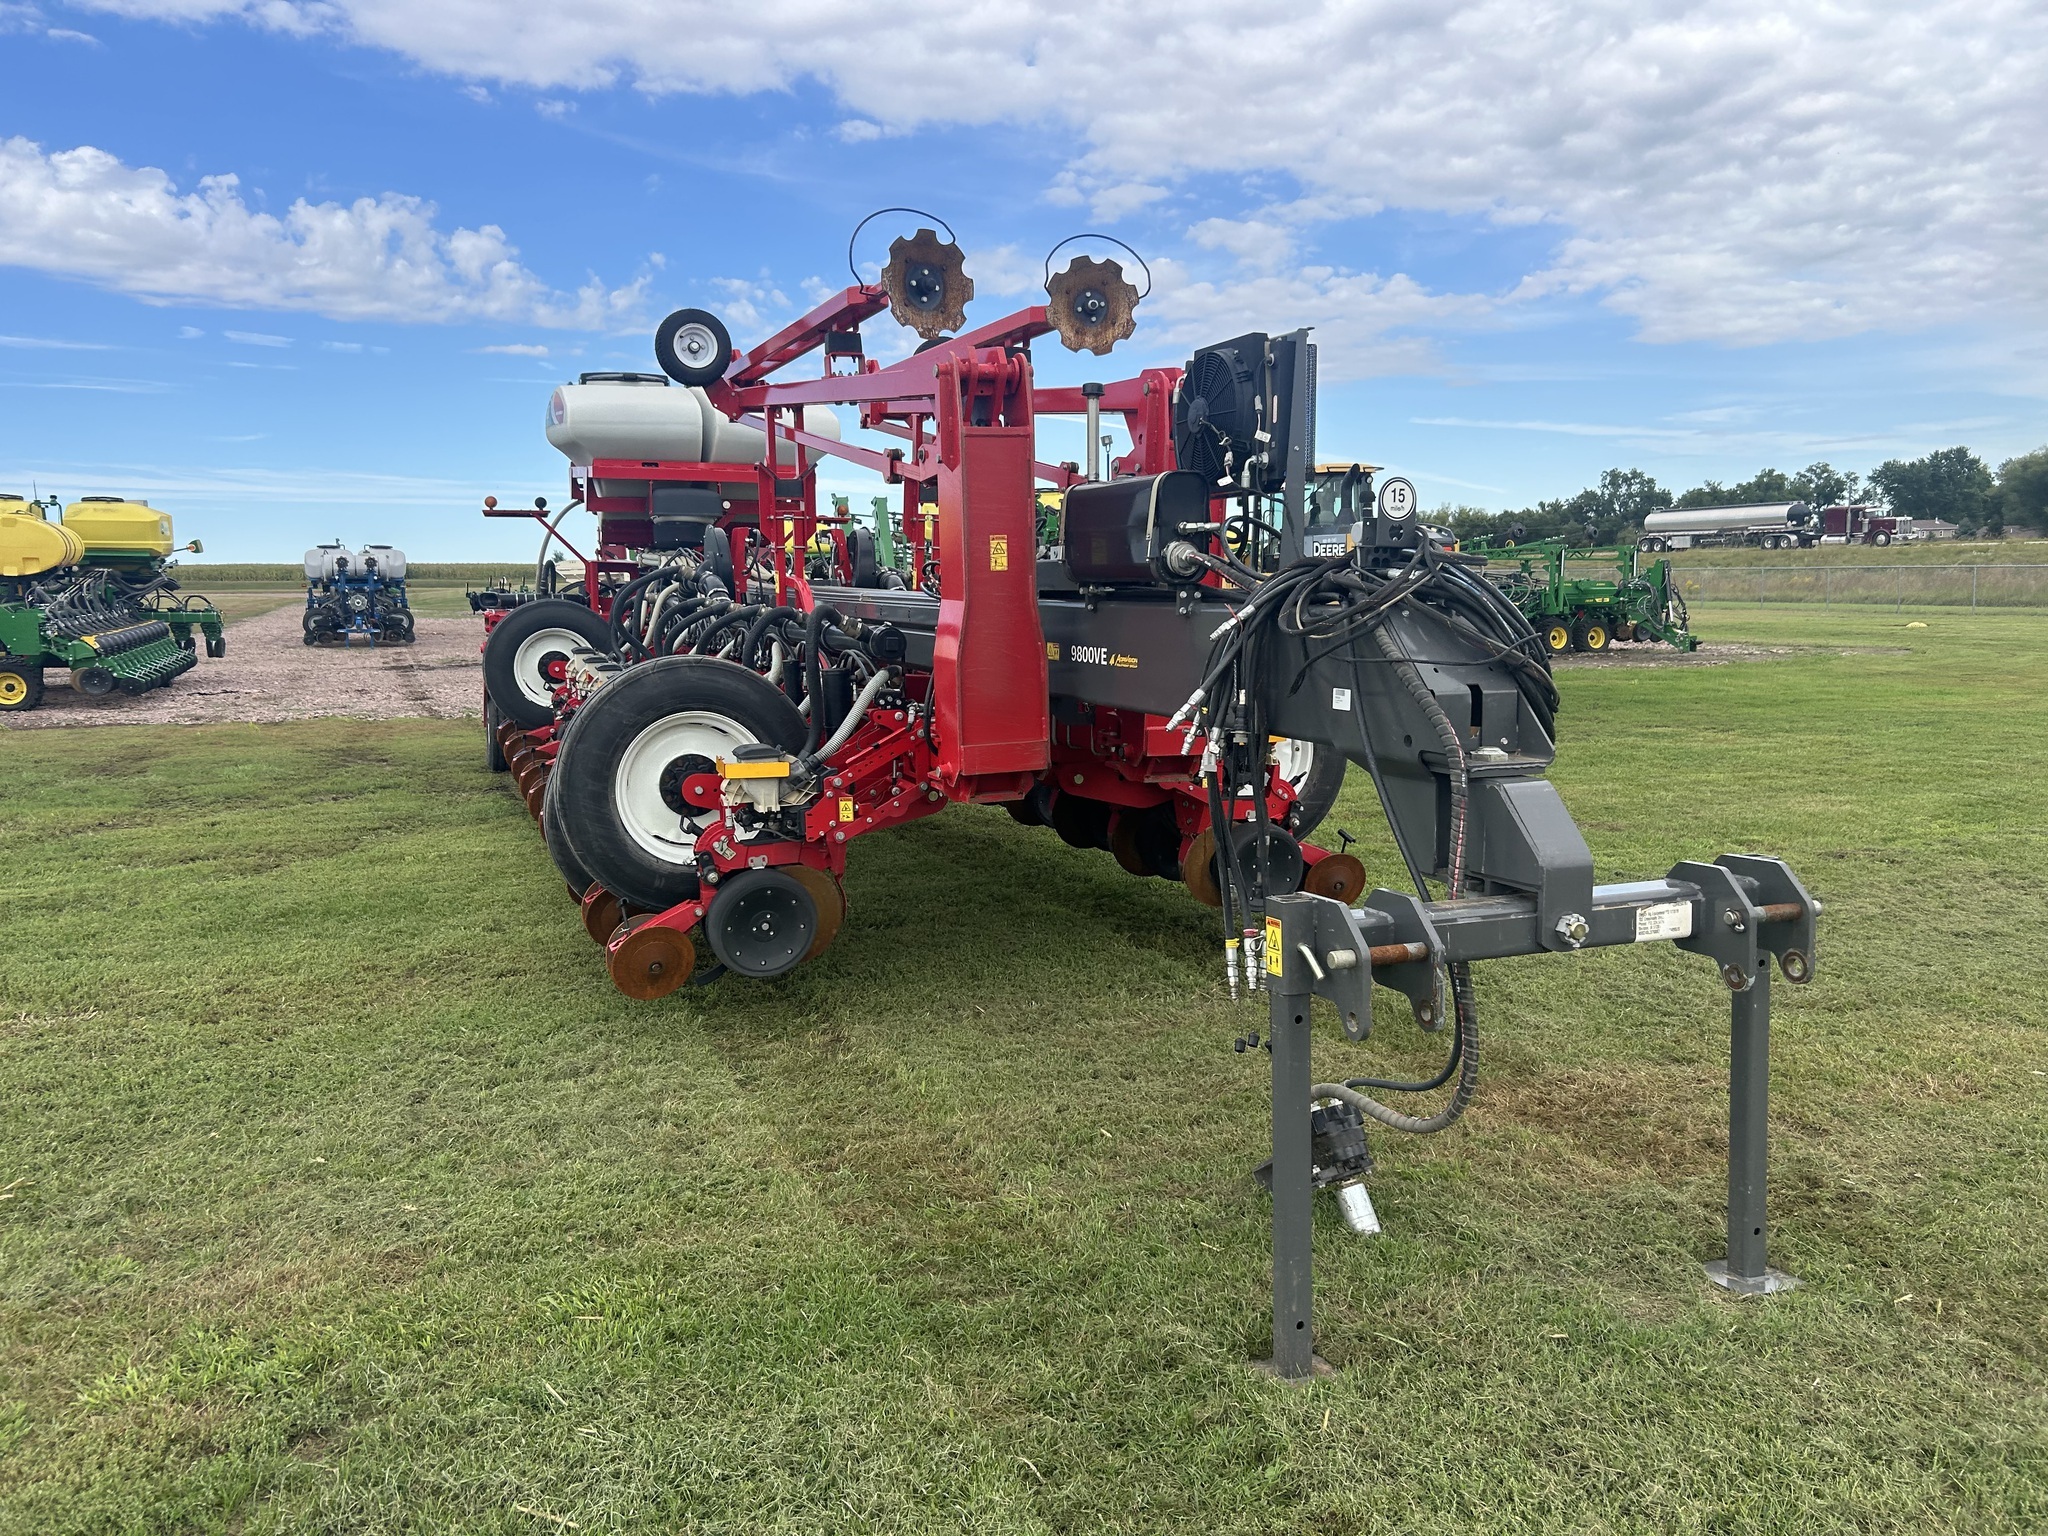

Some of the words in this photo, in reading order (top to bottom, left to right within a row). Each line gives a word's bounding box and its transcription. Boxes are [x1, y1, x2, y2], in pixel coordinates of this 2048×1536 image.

[1391, 488, 1405, 503] 15
[1313, 542, 1345, 556] DEERE
[1071, 645, 1107, 665] 9800VE
